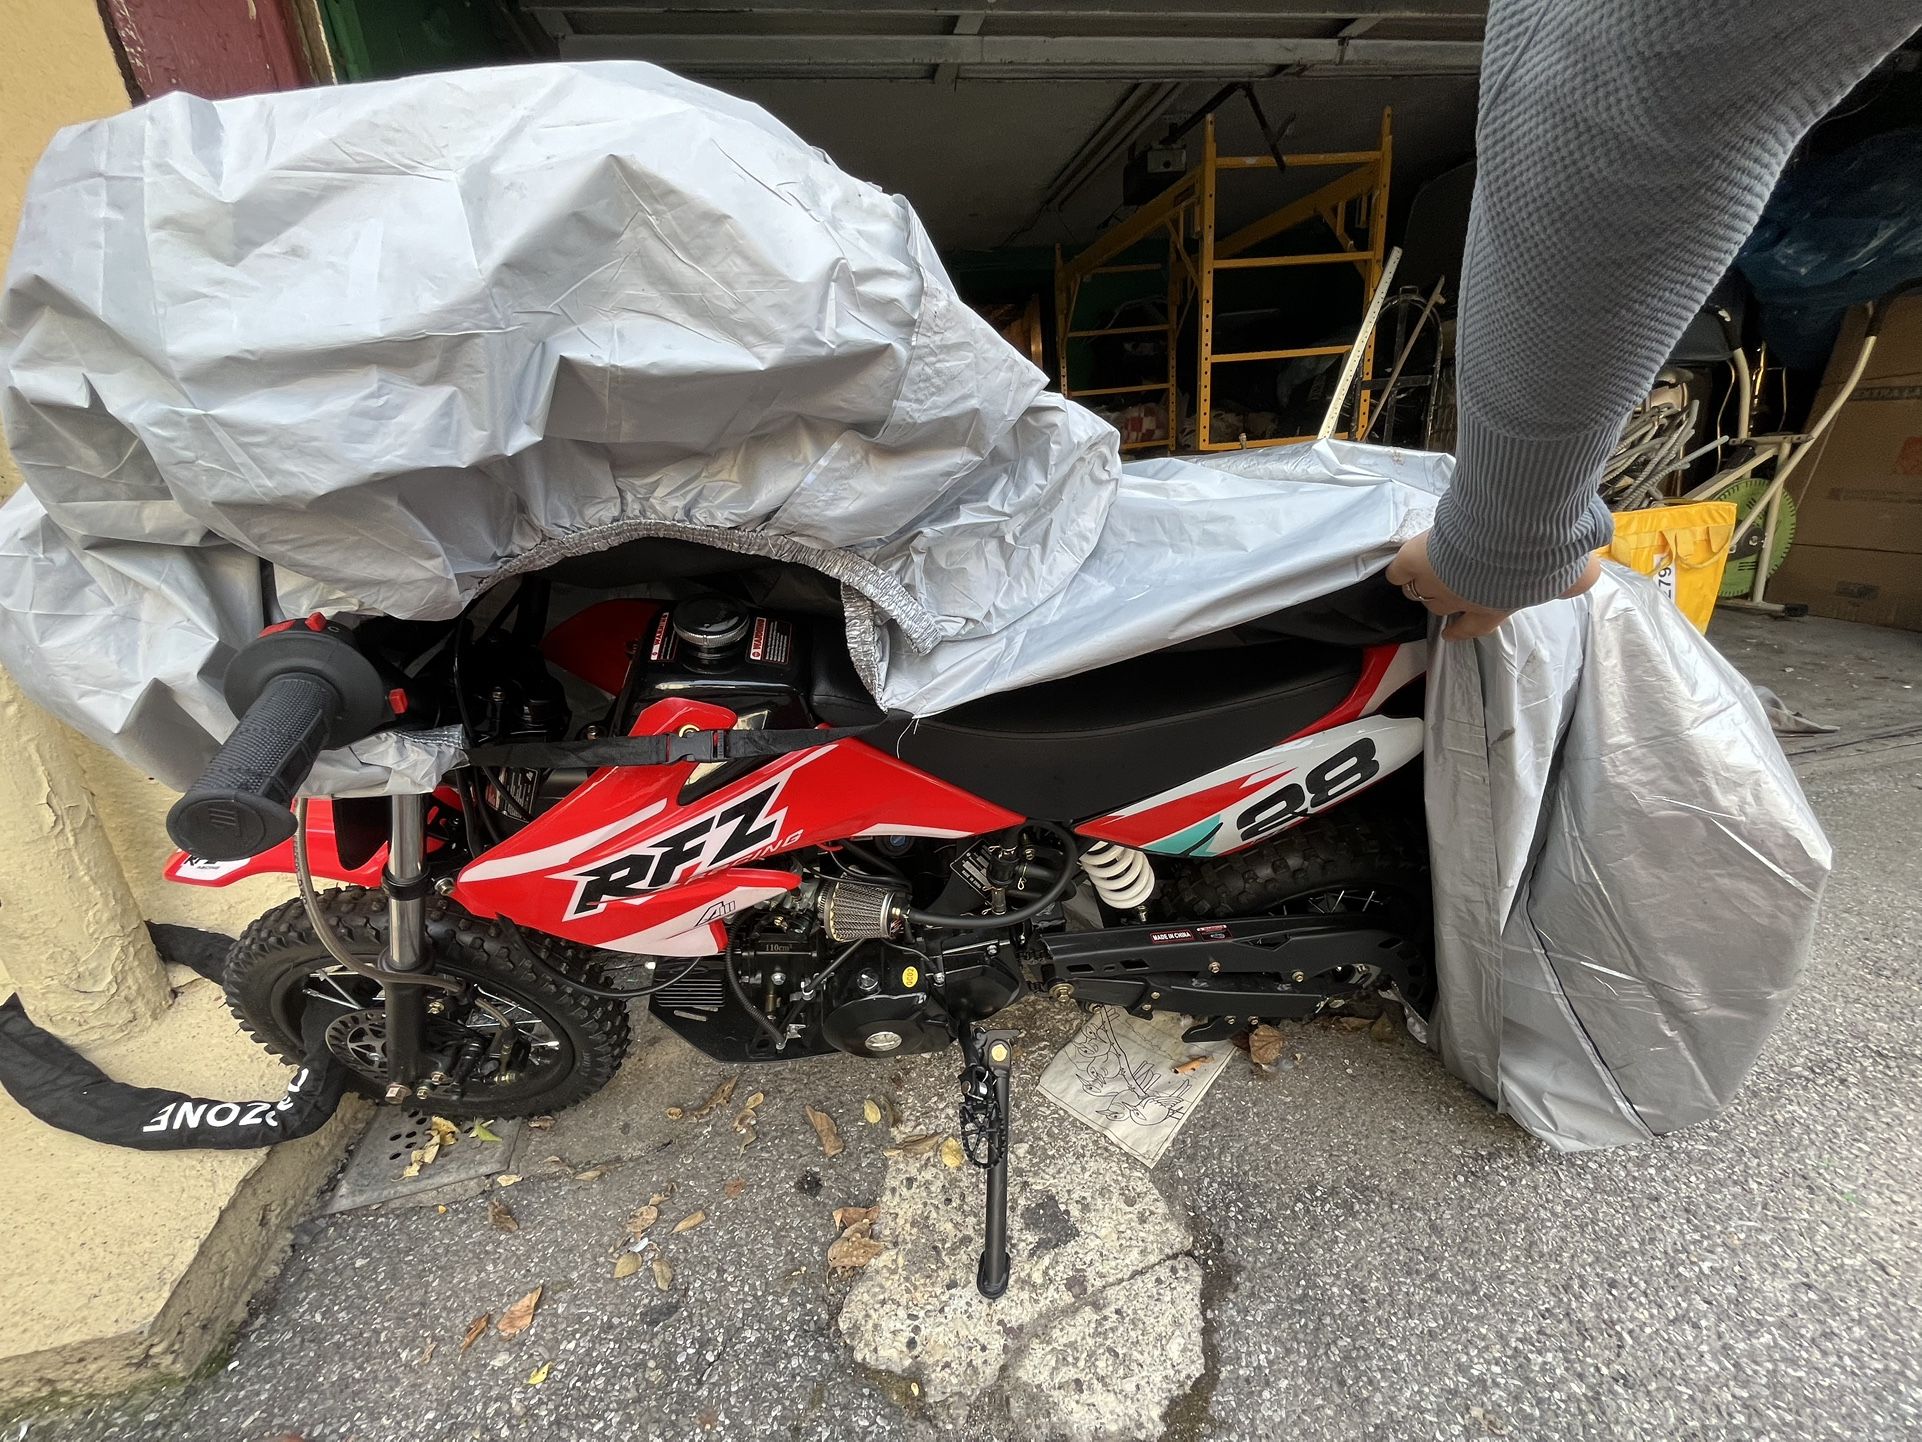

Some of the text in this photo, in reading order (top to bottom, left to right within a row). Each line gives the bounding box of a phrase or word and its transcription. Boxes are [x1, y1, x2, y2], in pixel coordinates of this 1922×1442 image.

[1236, 737, 1380, 842] 28
[572, 781, 778, 915] RFZ
[1152, 933, 1169, 941] MADE
[1174, 931, 1192, 939] CHINA
